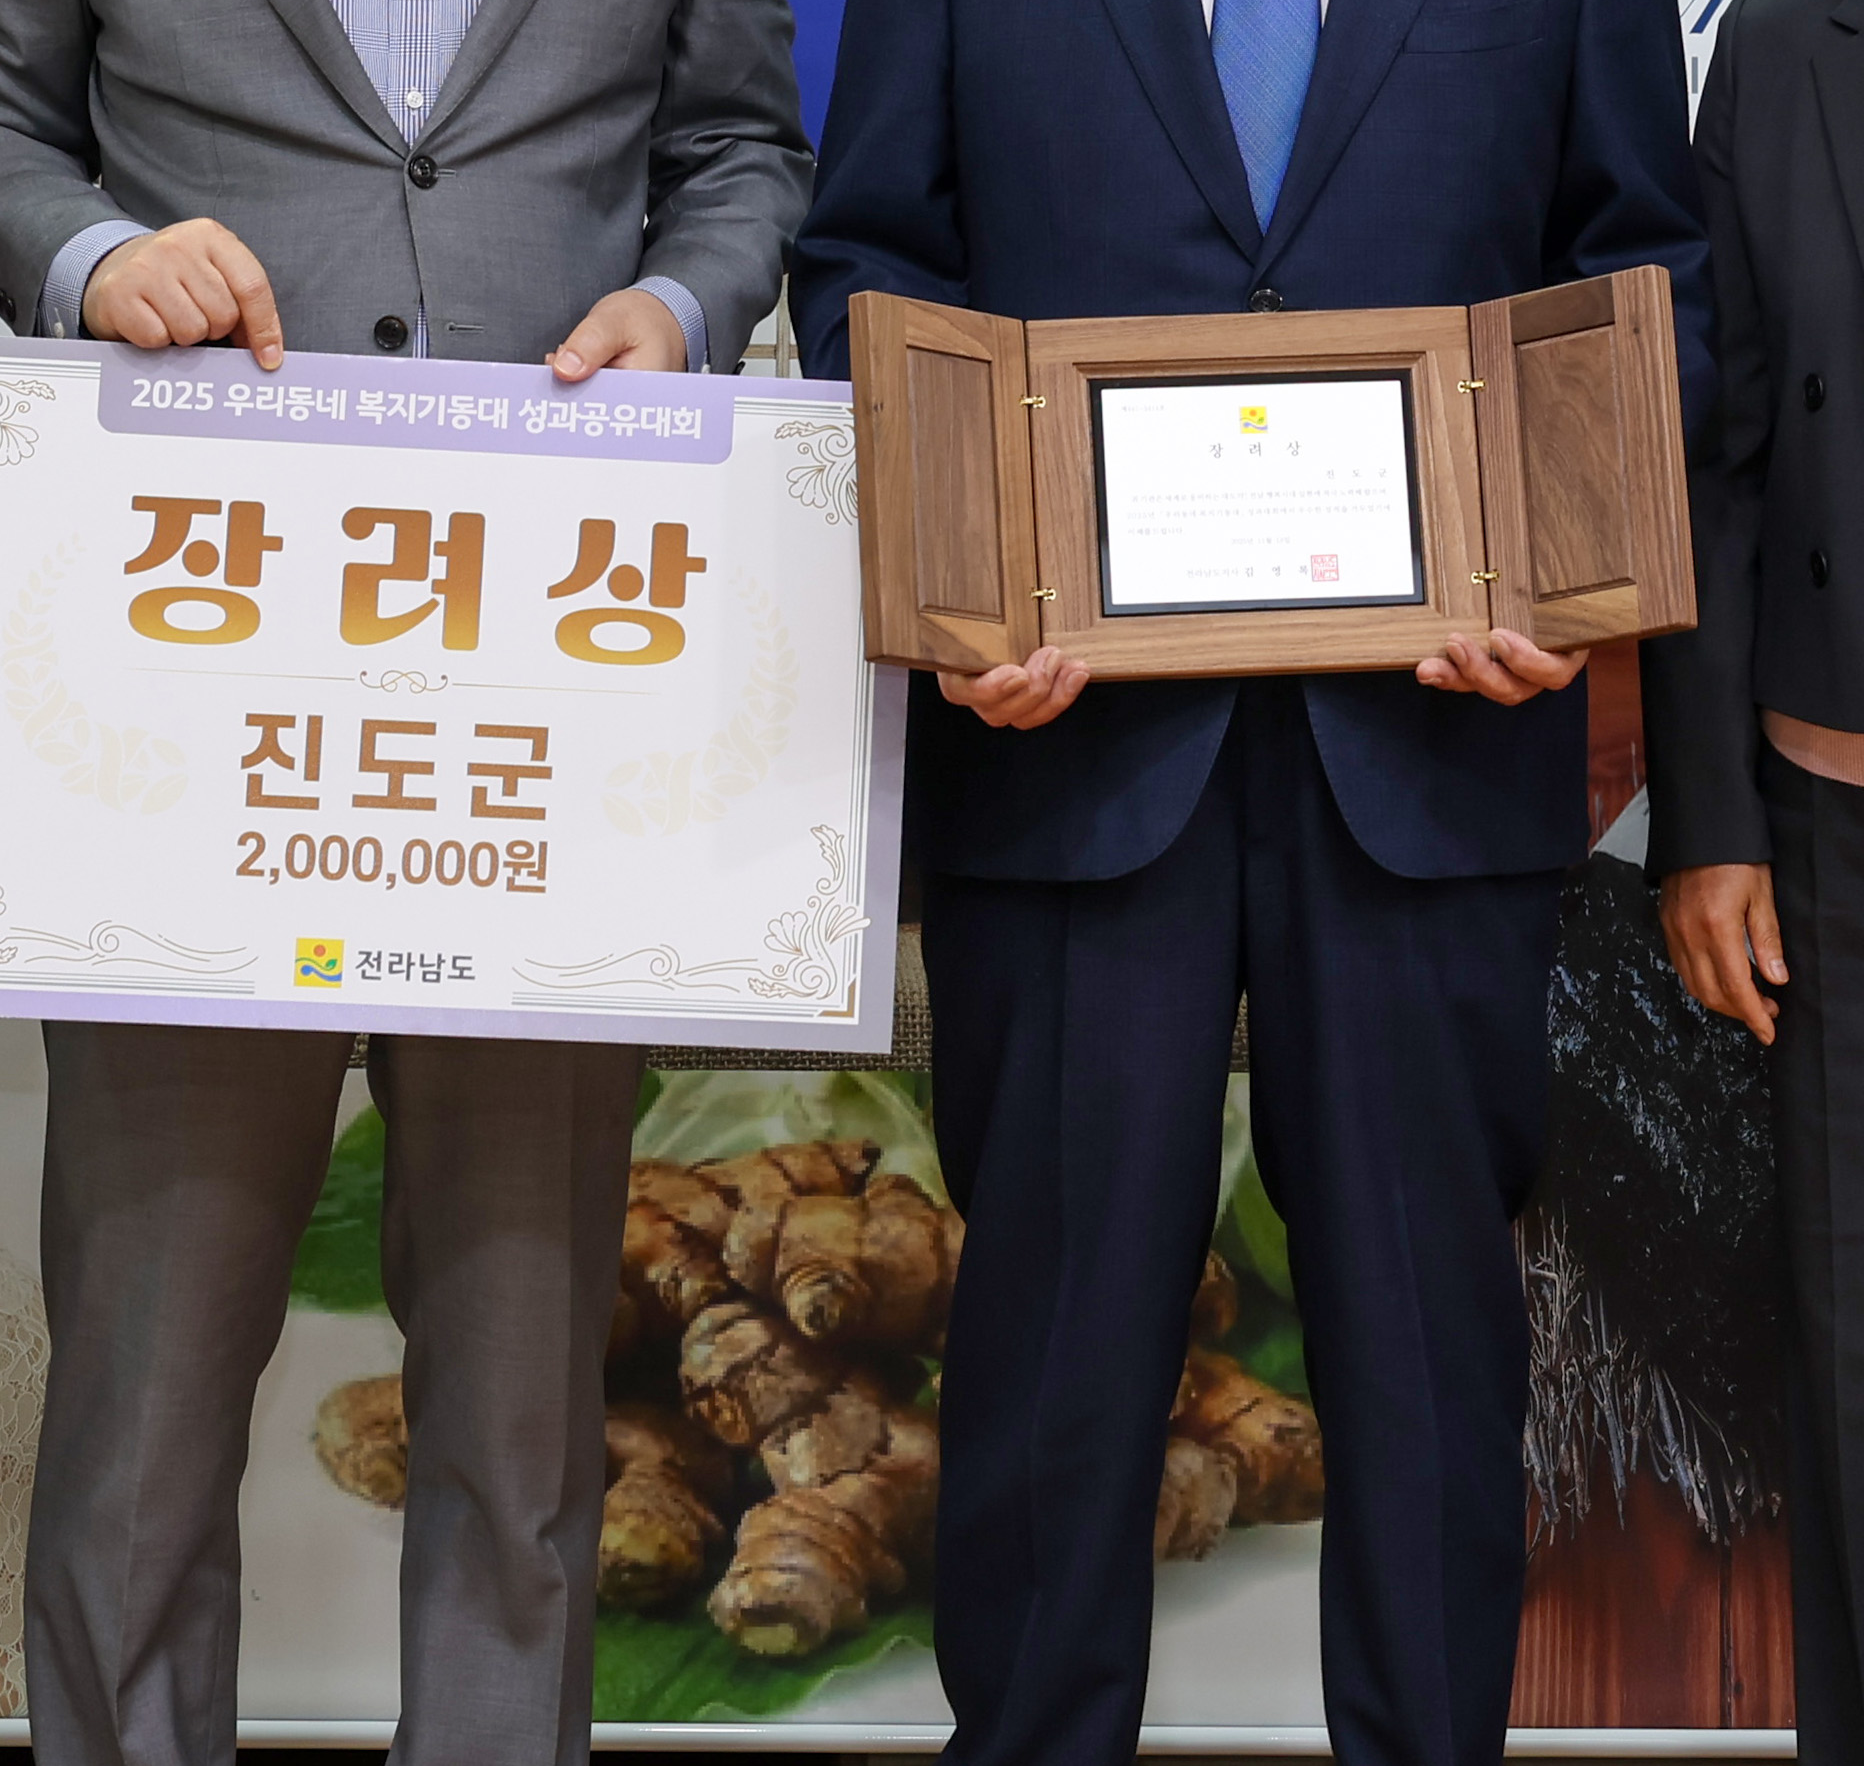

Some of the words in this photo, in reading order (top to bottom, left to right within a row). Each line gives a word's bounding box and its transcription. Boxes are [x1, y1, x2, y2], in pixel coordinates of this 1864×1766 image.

[130, 379, 215, 412] 2025
[222, 382, 348, 422] 우리동네
[354, 389, 510, 430] 복지기동대
[517, 397, 703, 440] 성과공유대회
[240, 712, 553, 821] 진도군
[236, 831, 549, 894] 2,000,000원
[354, 950, 476, 984] 전라남도
